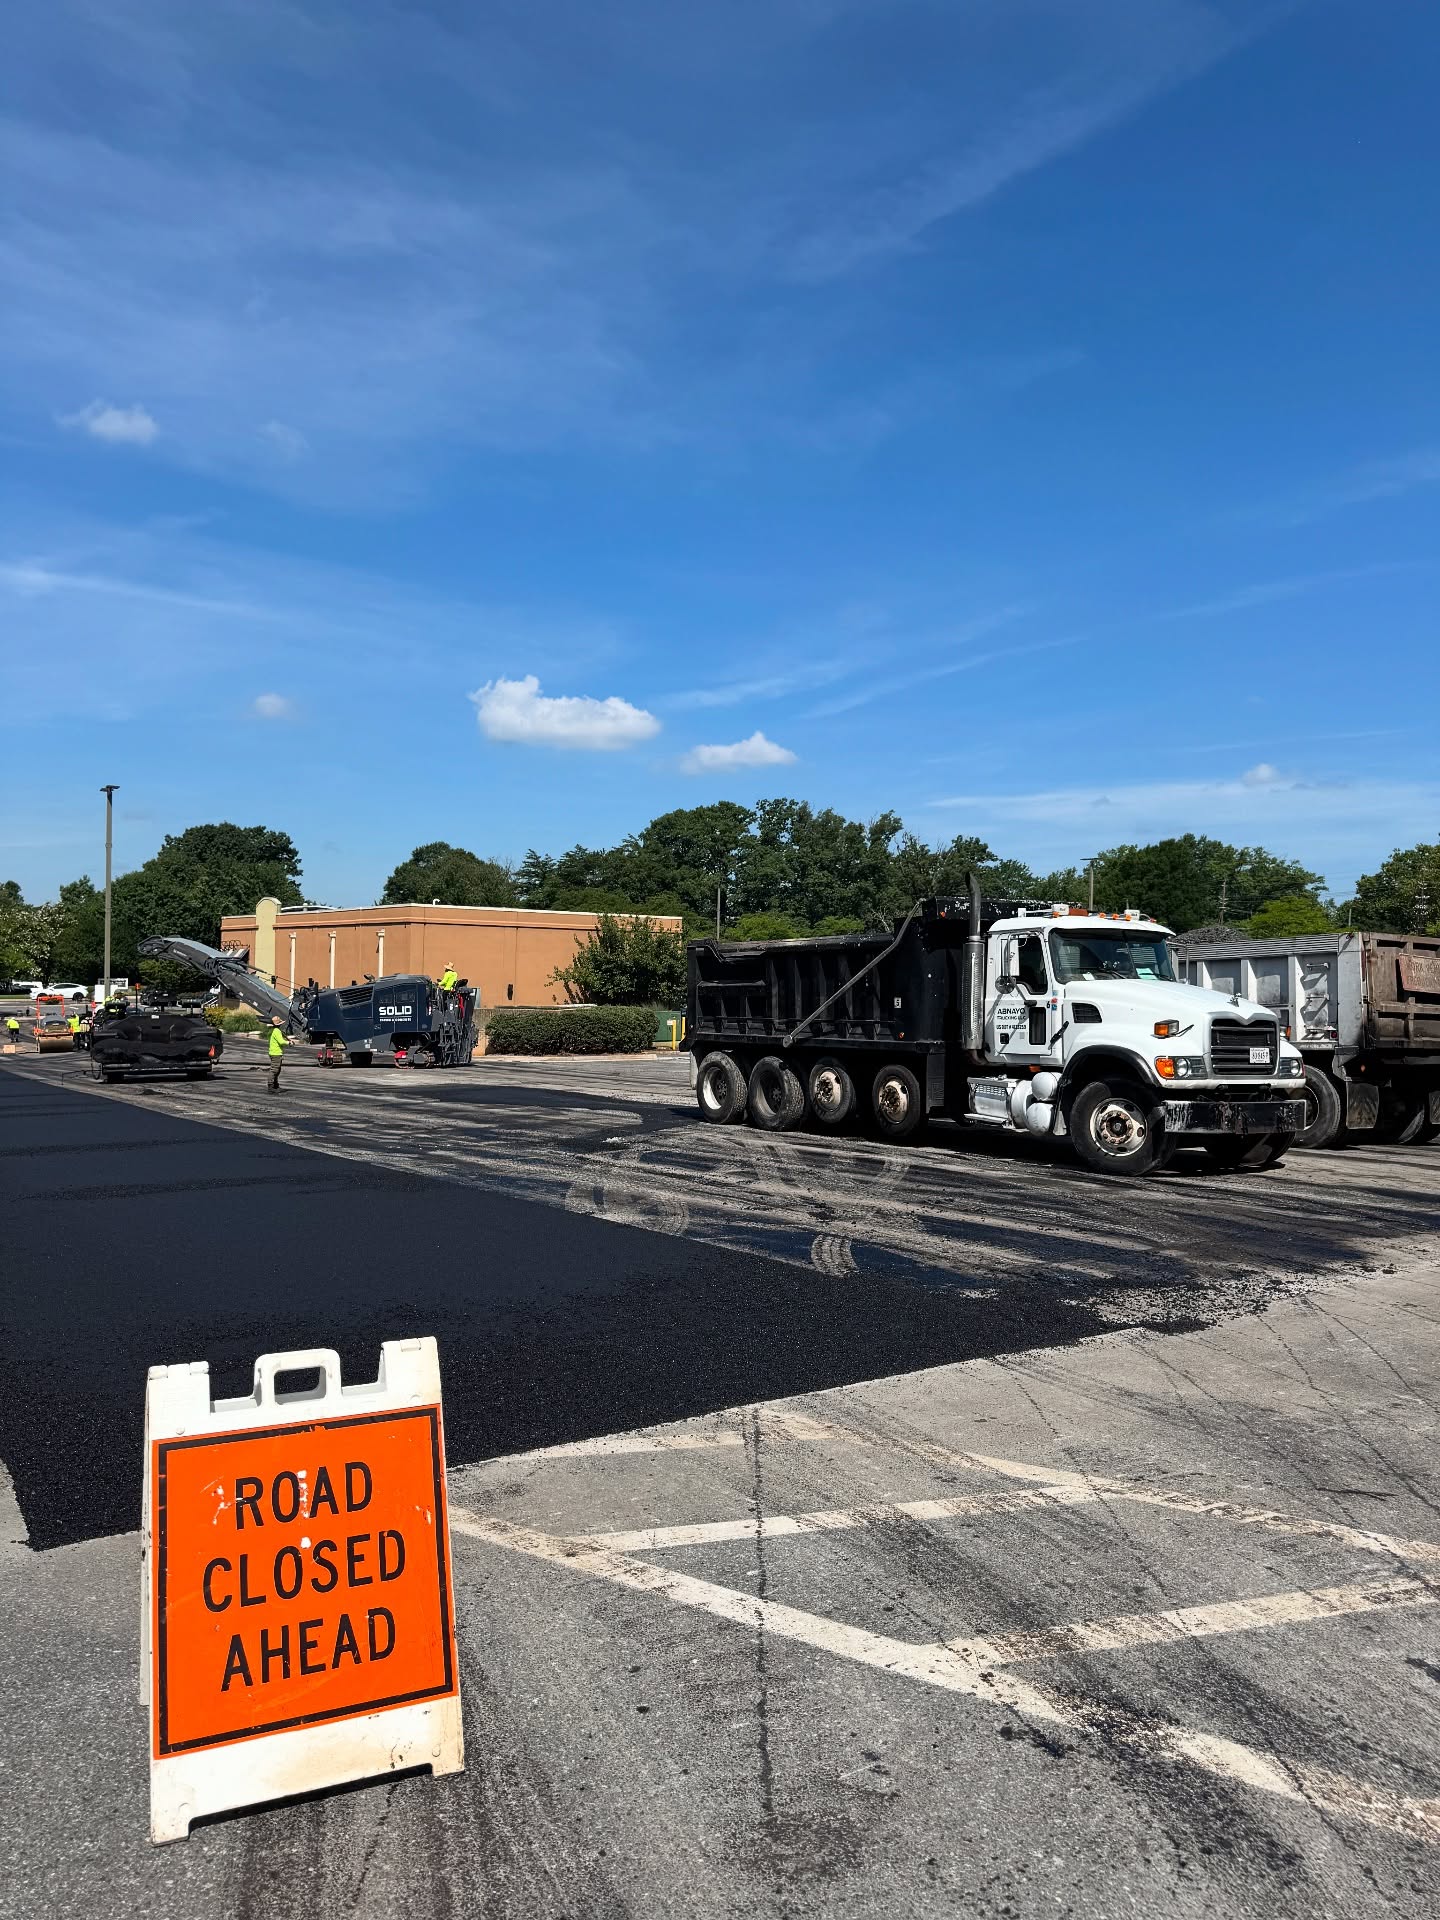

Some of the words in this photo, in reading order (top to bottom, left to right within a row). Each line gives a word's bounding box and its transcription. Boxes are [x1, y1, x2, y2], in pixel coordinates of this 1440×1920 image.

[379, 1005, 411, 1016] SOLID
[236, 1462, 373, 1530] ROAD
[203, 1530, 406, 1613] CLOSED
[221, 1607, 396, 1692] AHEAD
